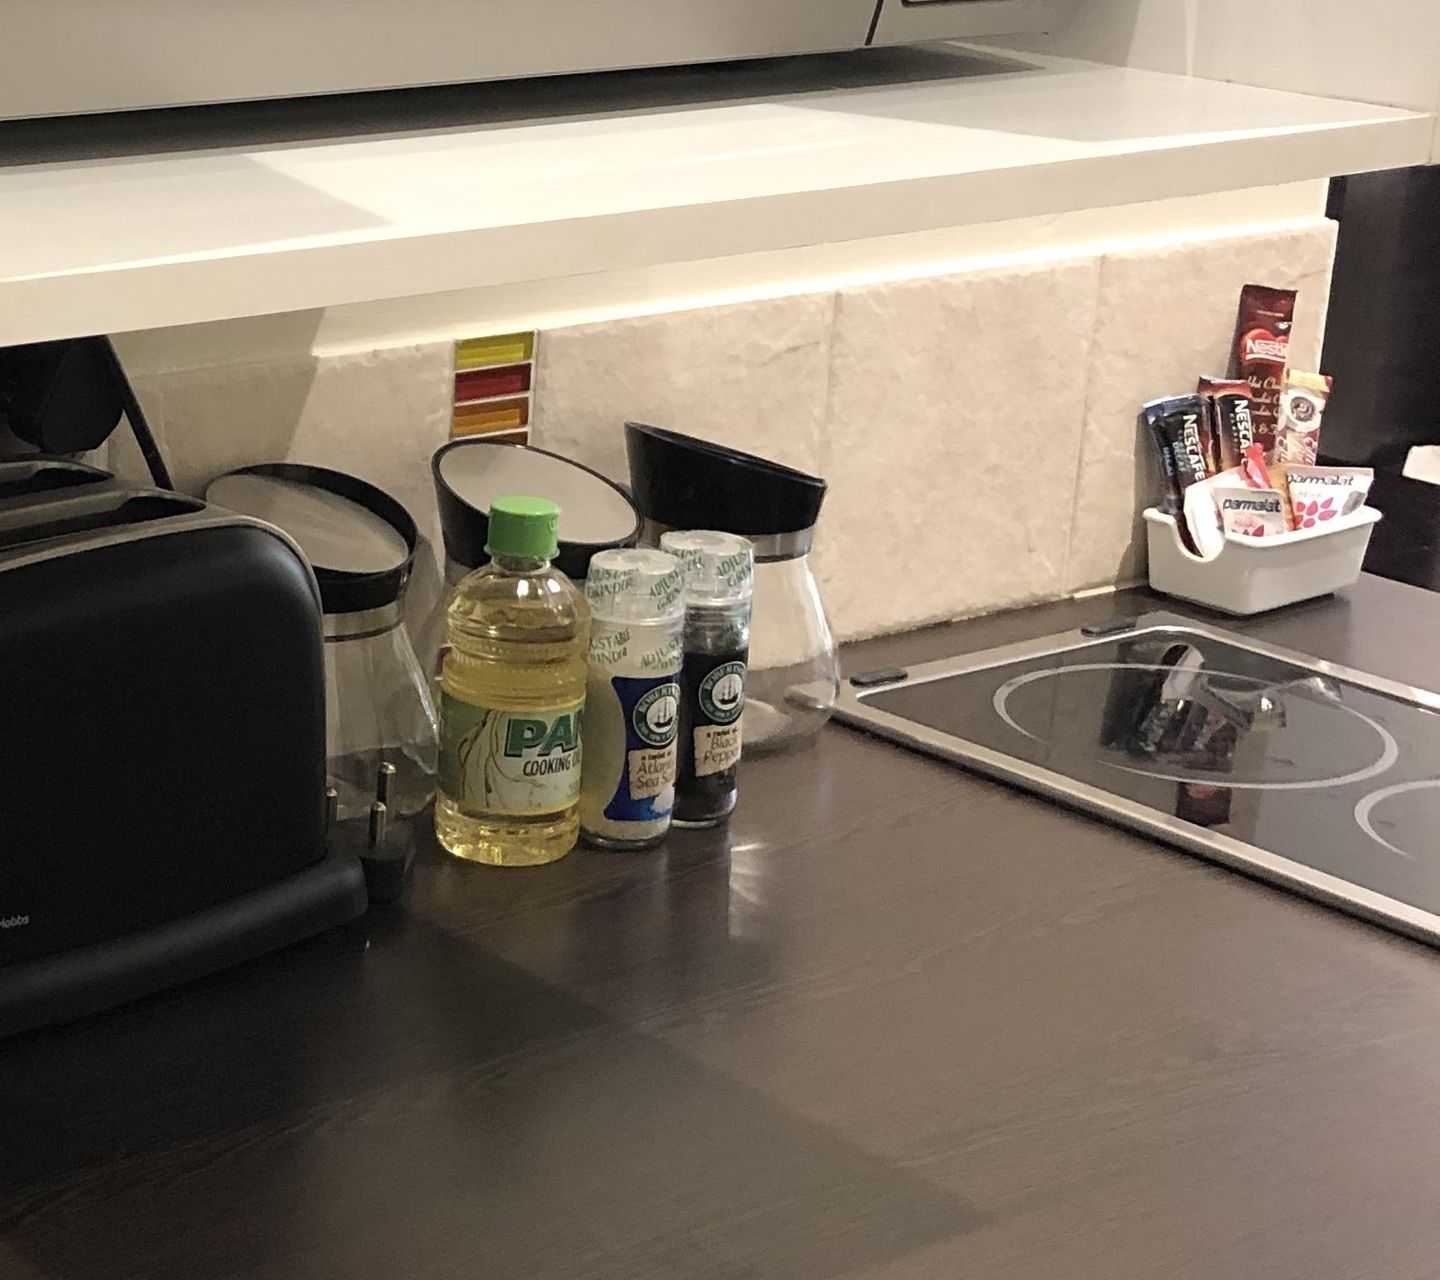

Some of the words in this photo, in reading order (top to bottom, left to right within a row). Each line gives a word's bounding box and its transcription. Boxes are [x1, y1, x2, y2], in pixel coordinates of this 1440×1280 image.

[1234, 400, 1253, 455] NESCA
[1222, 498, 1281, 513] parmalat
[522, 754, 571, 777] COOKING
